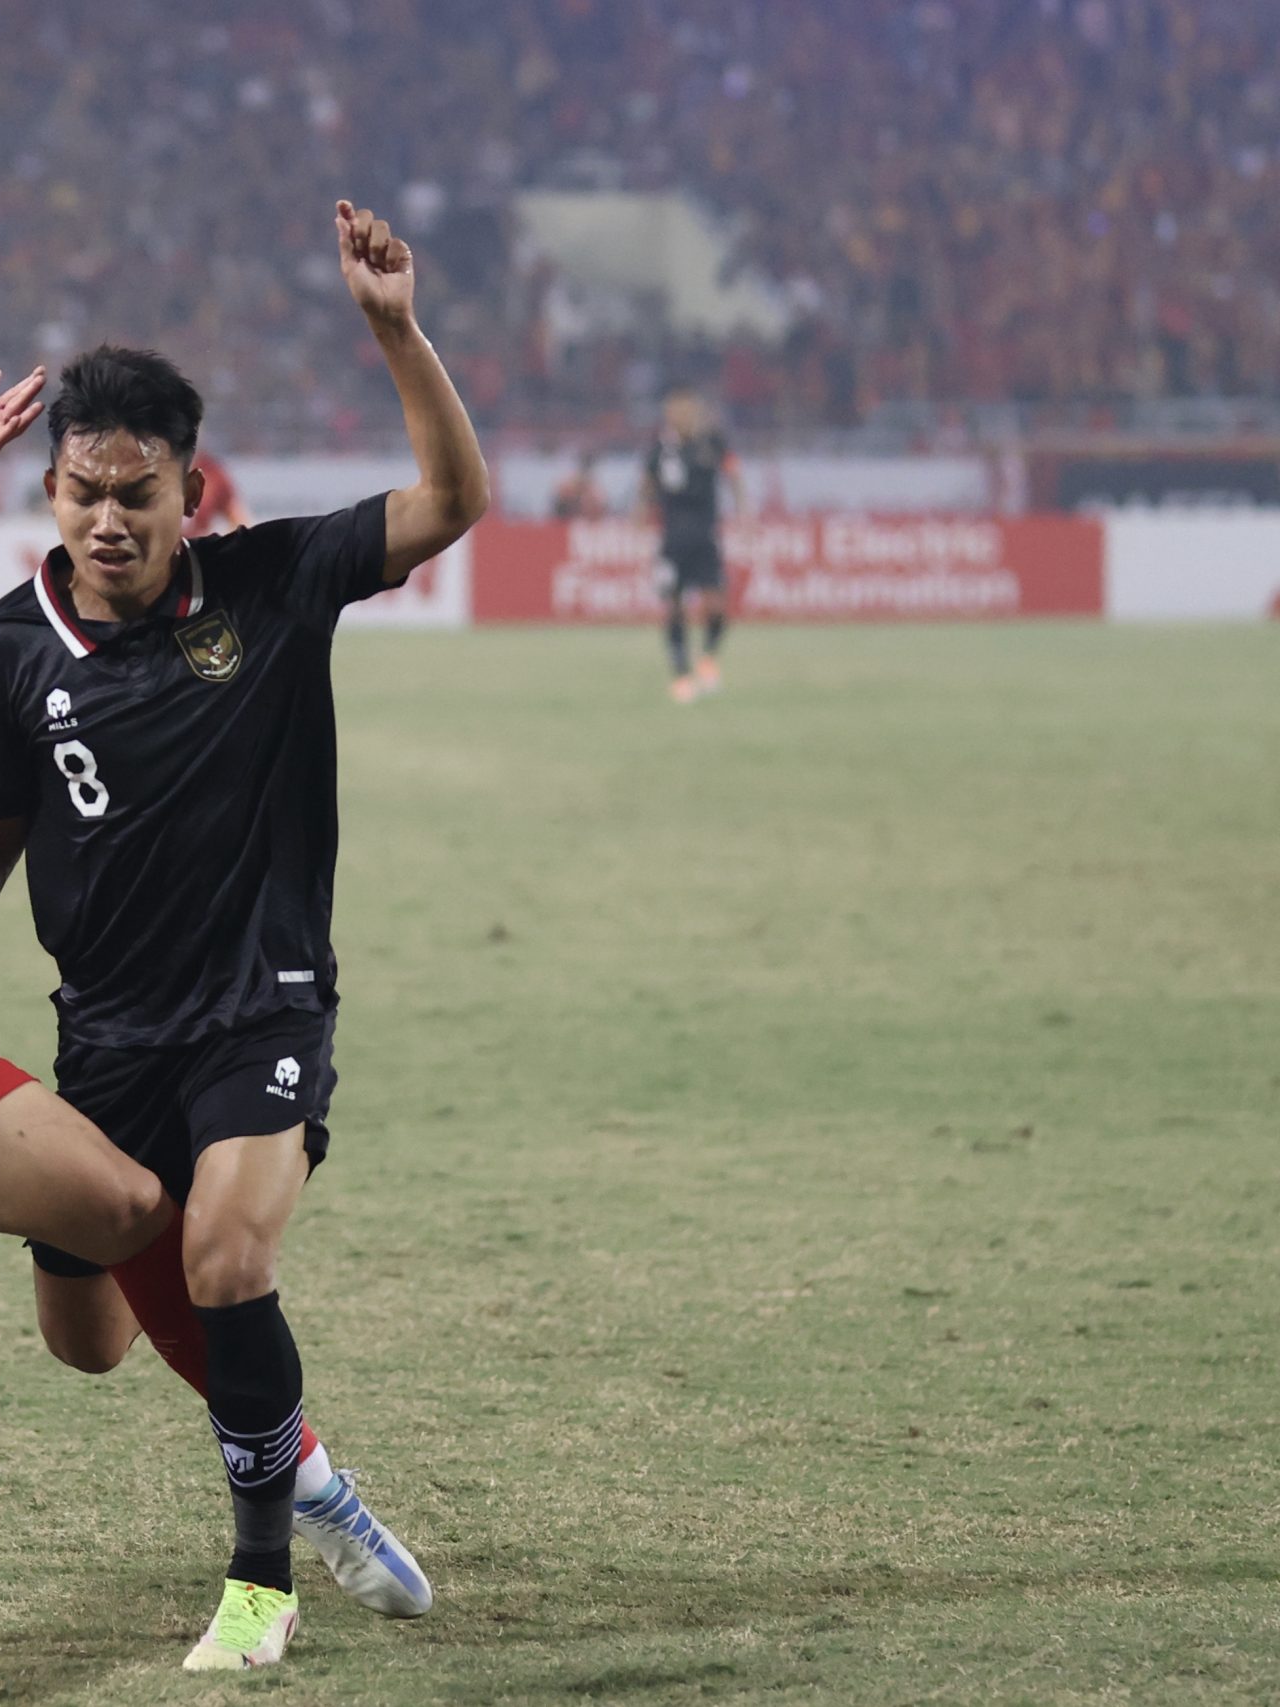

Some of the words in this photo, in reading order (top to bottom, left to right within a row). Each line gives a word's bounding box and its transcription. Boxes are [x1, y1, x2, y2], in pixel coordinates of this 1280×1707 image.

[48, 717, 79, 732] MILLS
[53, 739, 110, 818] 8
[265, 1084, 296, 1101] MILLS
